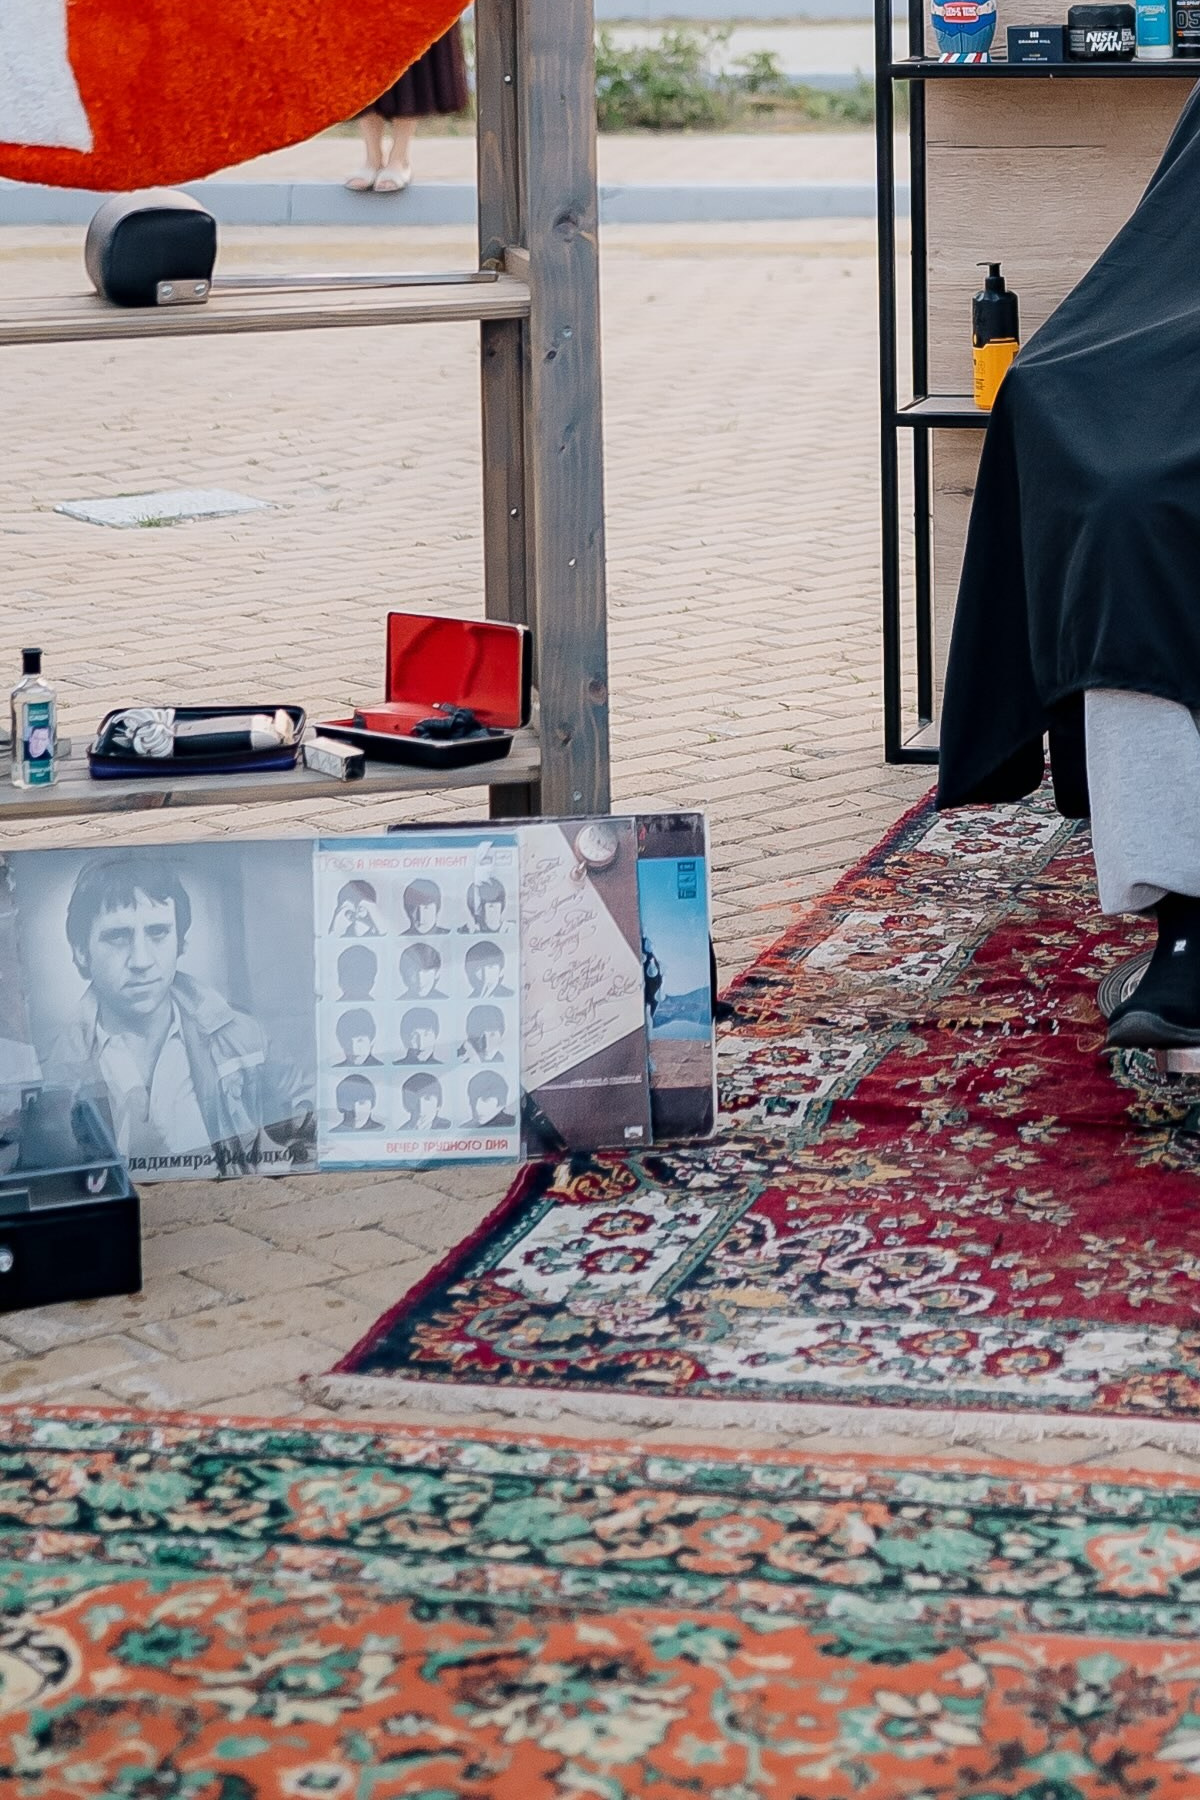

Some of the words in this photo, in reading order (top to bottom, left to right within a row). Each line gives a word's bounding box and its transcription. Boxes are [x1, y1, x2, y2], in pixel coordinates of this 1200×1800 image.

[1085, 31, 1118, 43] NISH
[1090, 40, 1122, 52] MAN
[434, 855, 468, 867] NIGHT
[386, 1142, 419, 1154] ВЕЧЕР
[423, 1140, 482, 1153] ТРУДНОГО
[485, 1139, 508, 1151] ДНЯ
[128, 1153, 213, 1172] ладимира
